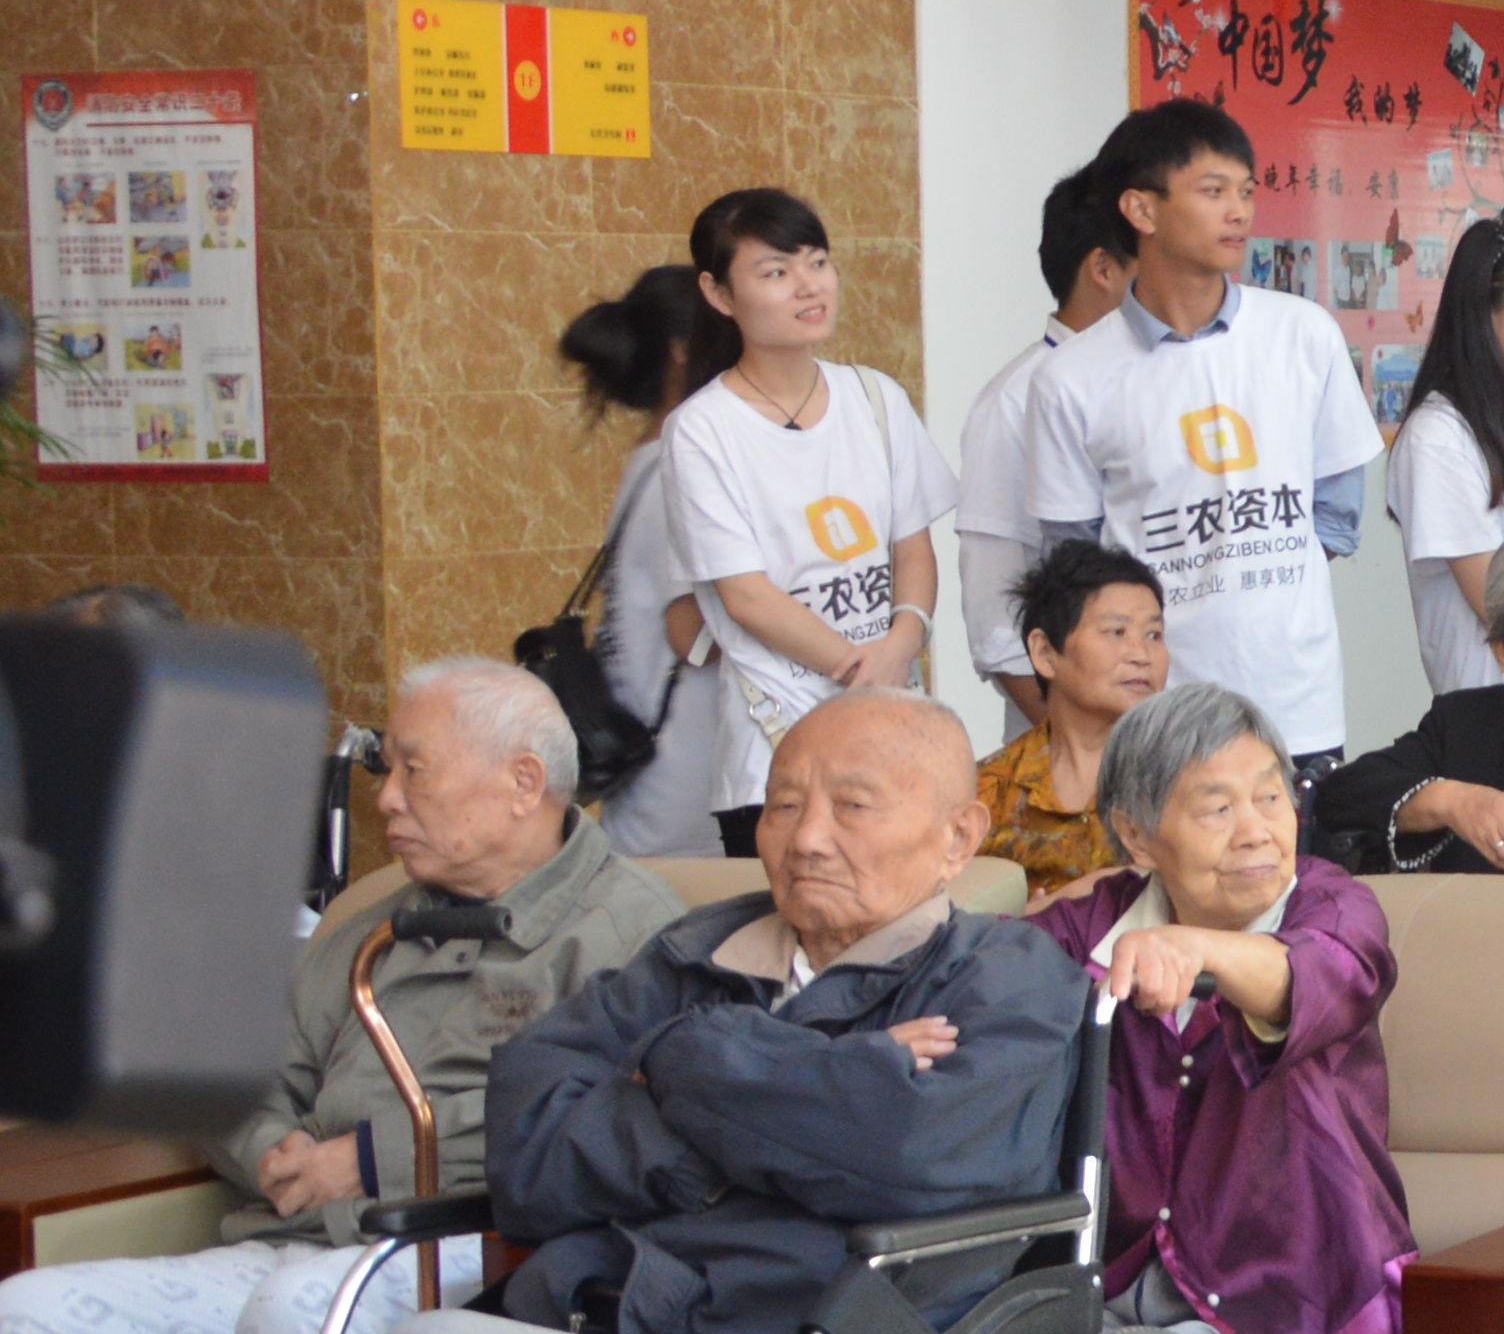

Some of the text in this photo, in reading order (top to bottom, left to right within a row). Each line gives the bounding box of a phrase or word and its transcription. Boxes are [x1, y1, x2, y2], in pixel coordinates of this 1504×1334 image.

[1343, 75, 1423, 132] 我的梦
[1140, 482, 1307, 553] 三农资本
[1163, 572, 1227, 608] 农立业
